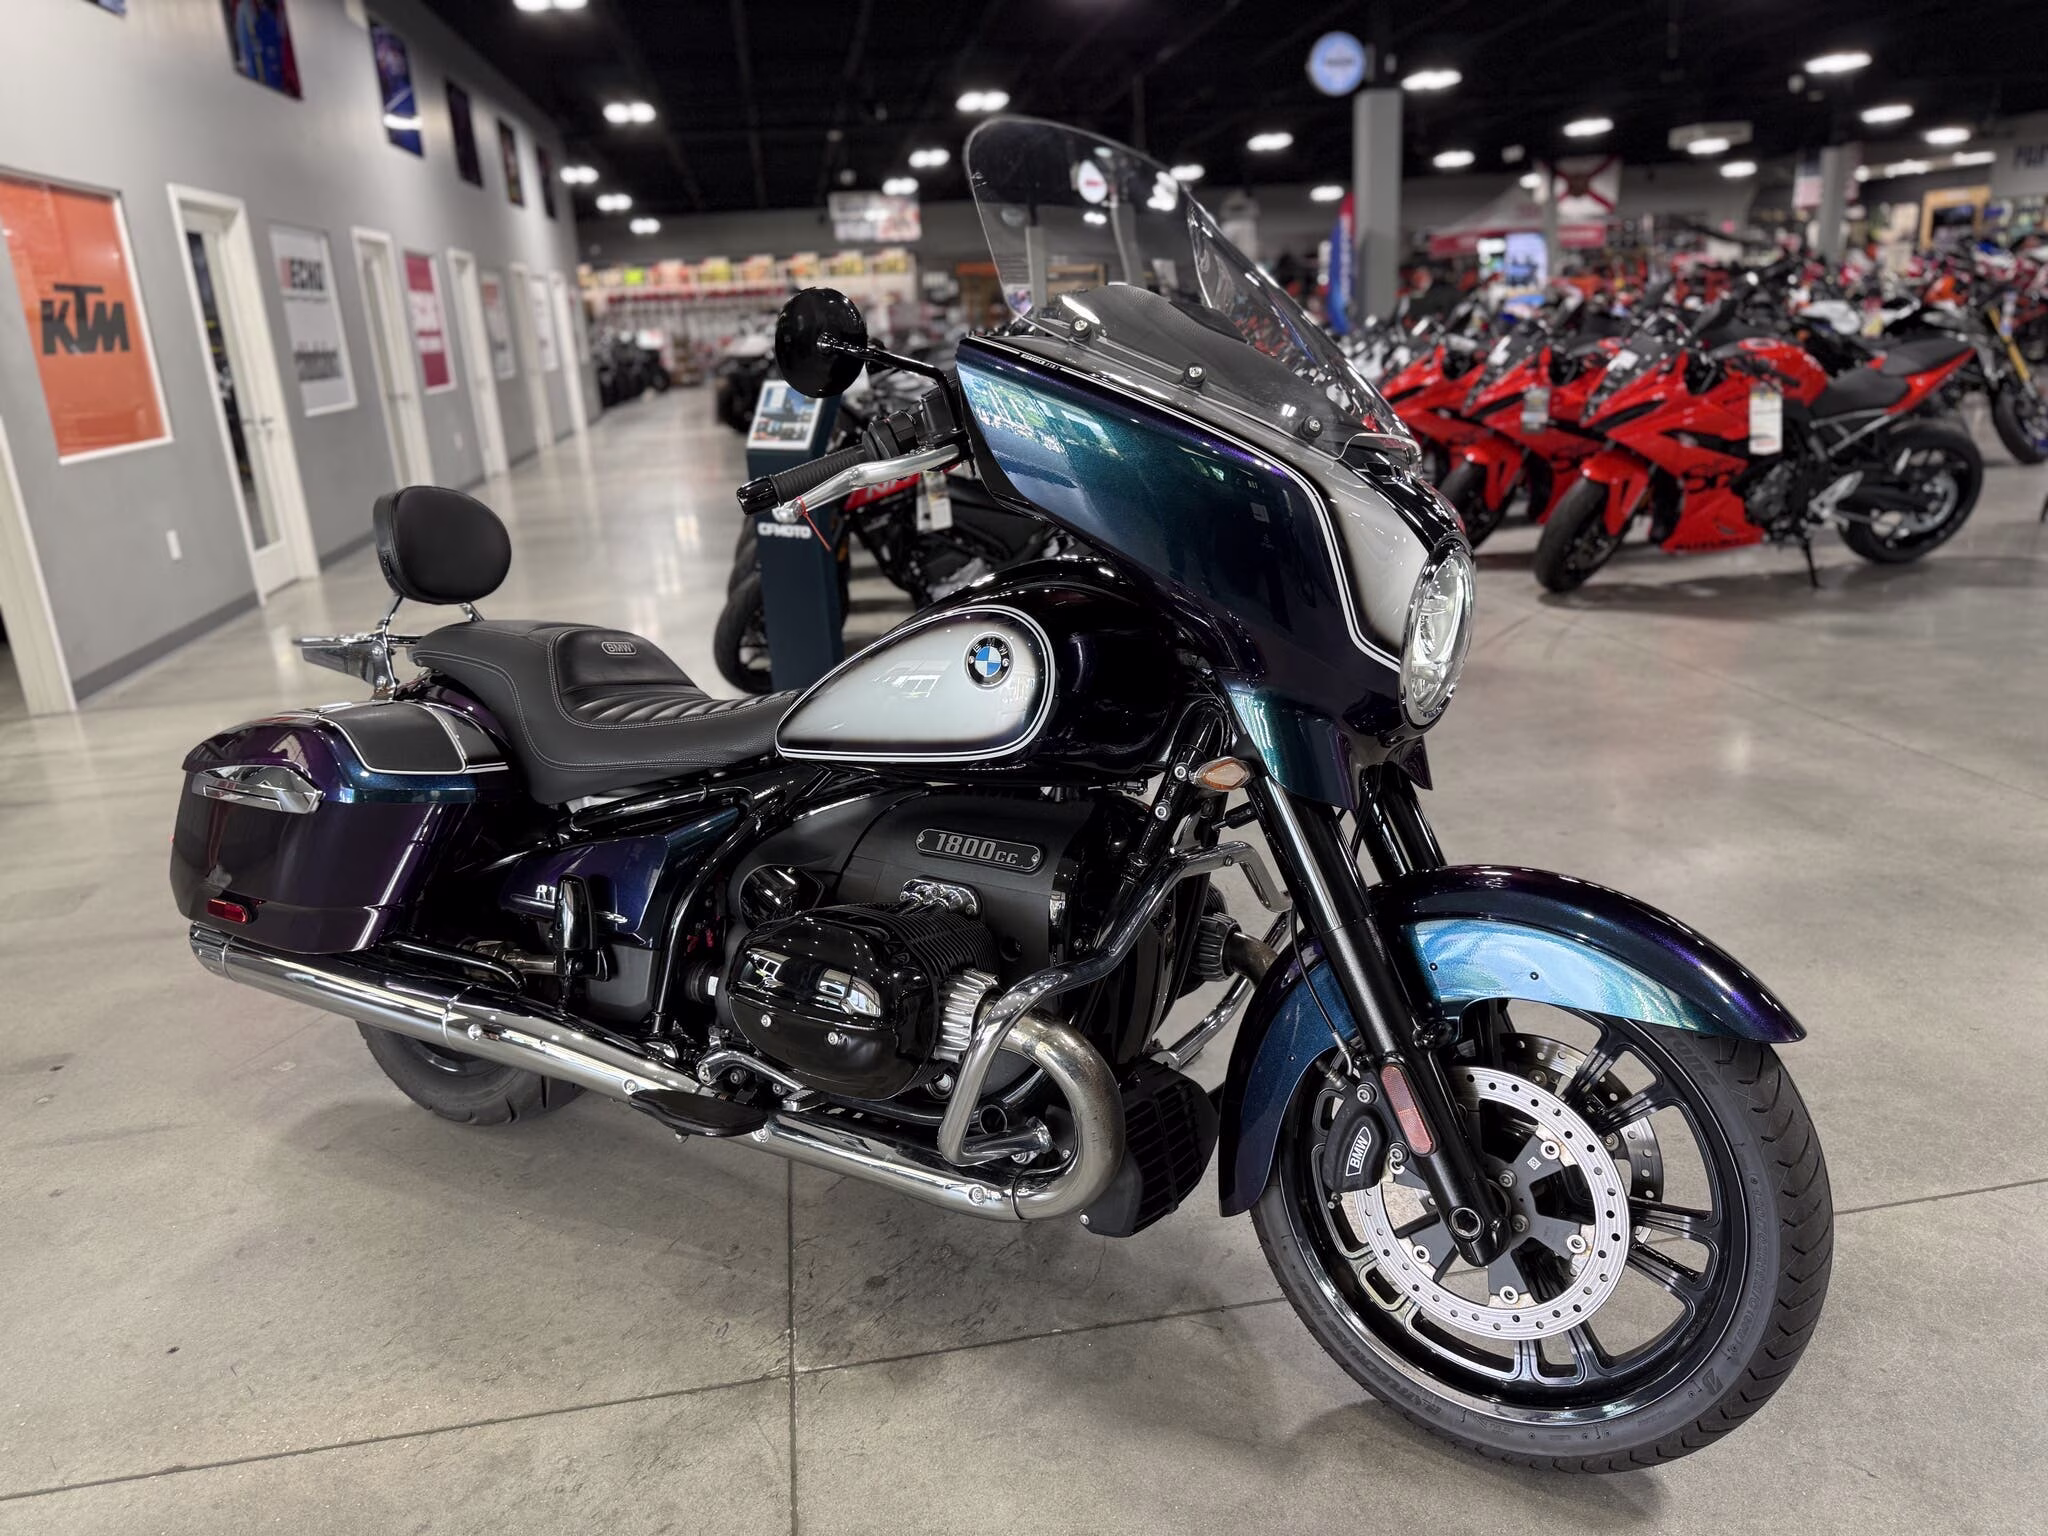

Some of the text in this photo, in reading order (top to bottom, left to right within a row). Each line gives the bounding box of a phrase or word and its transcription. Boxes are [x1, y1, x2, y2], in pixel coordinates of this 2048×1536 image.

[41, 283, 130, 355] KTM
[757, 521, 812, 540] CFMOTO
[605, 643, 632, 652] BMW
[972, 637, 1009, 656] BMW
[535, 884, 556, 903] R1
[1350, 1135, 1369, 1169] BMW
